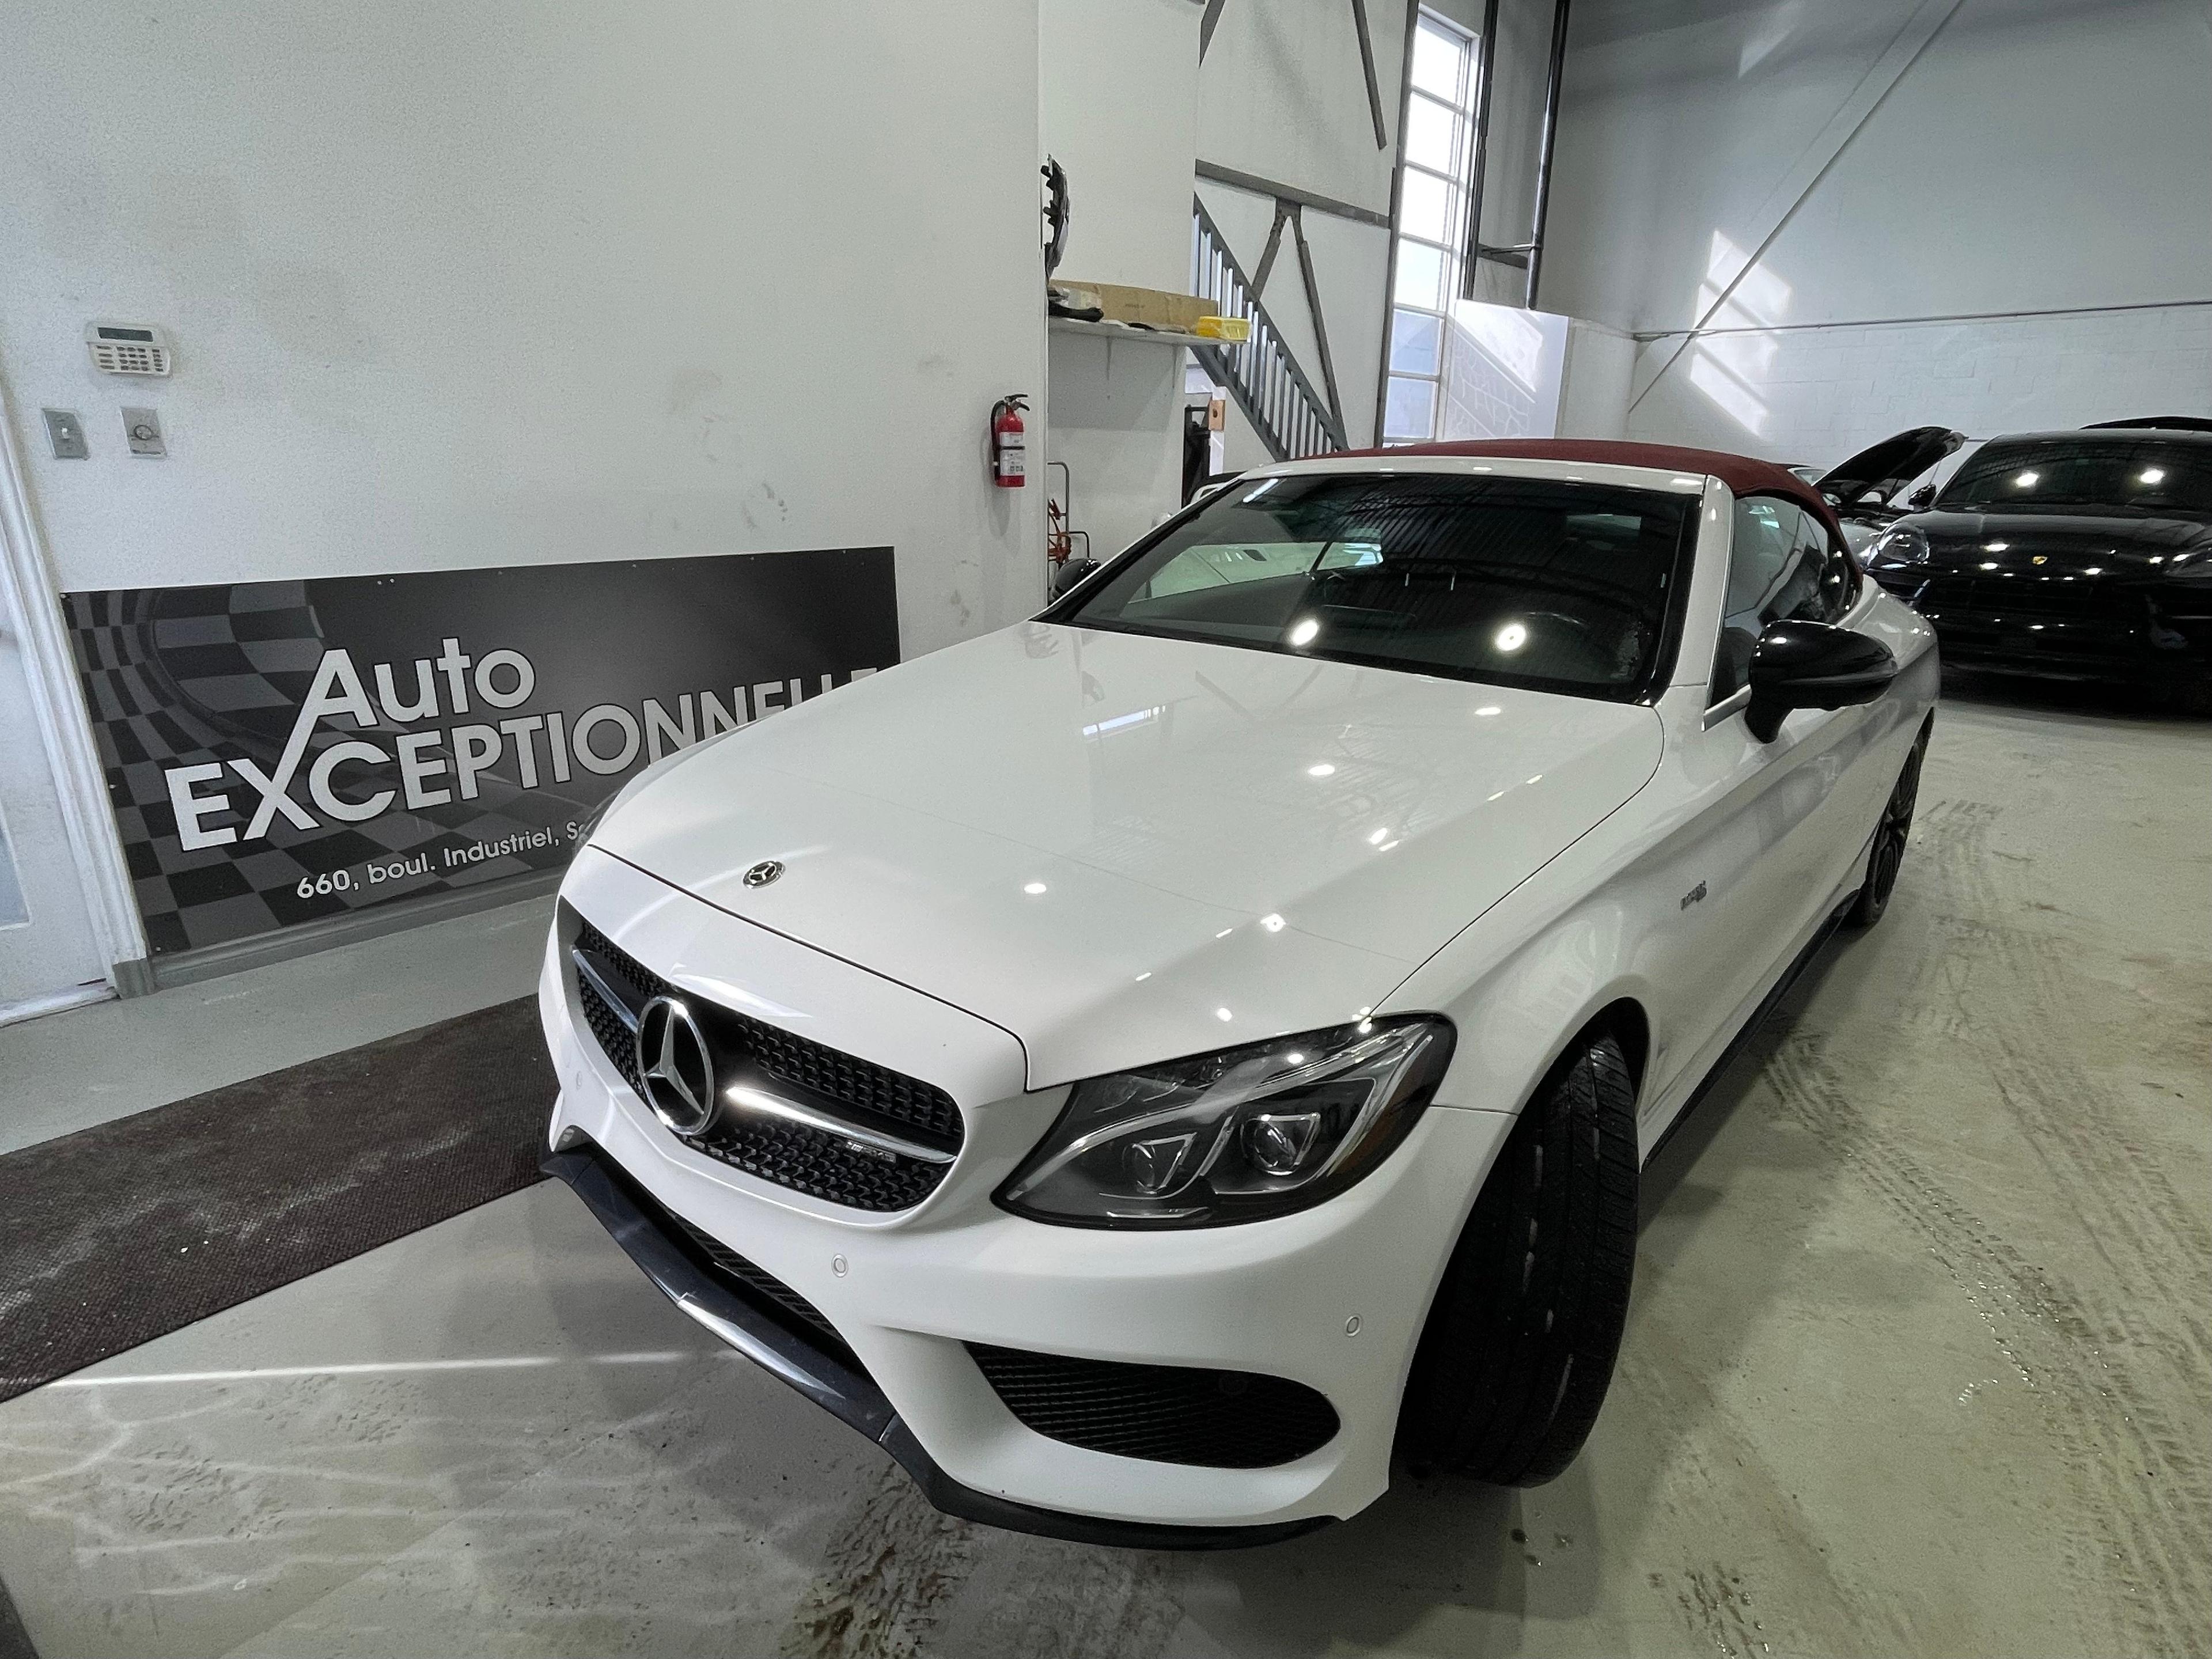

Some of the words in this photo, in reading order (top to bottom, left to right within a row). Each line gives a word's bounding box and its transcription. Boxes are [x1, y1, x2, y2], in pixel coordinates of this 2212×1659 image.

[291, 638, 536, 728] Auto
[164, 667, 877, 851] EXCEPTIONNE
[297, 869, 359, 899] 660,
[367, 853, 436, 884] boul.
[443, 826, 559, 867] Industriel,
